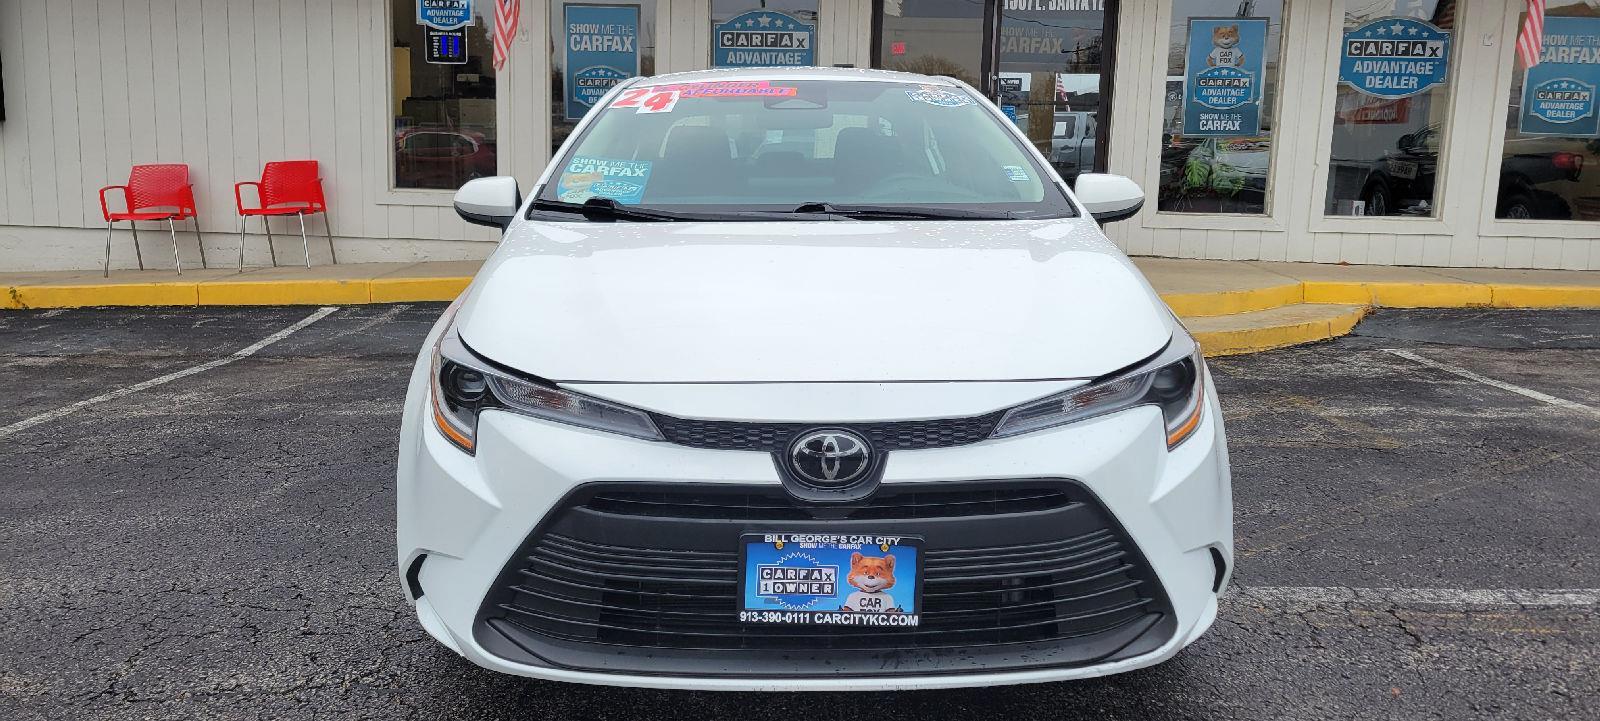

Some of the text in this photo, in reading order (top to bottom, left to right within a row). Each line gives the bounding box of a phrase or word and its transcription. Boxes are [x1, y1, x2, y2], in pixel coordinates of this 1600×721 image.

[424, 0, 467, 8] CARFAX
[570, 24, 634, 35] SHOW ME THE
[570, 35, 634, 52] CARFAX
[723, 33, 807, 48] CARFAX
[1542, 34, 1600, 46] HOW ME TH
[1350, 41, 1441, 57] CARFAX
[727, 51, 802, 64] ADVANTAGE
[1353, 61, 1434, 74] ADVANTAGE
[1200, 79, 1248, 87] CARFAX
[1366, 76, 1419, 89] DEALER
[581, 88, 608, 96] ADVAN
[684, 87, 789, 95] AFFORDABLE
[1201, 88, 1245, 96] ADVANTAGE
[1538, 92, 1589, 101] CARFAX
[1540, 102, 1584, 110] ADVANTAGE
[1546, 110, 1576, 118] DEALER
[1200, 121, 1241, 130] CARFAX
[573, 157, 608, 166] SHOW
[569, 163, 649, 176] CARFAX
[764, 534, 900, 546] BILL GEORGE'S CAR CITY
[761, 568, 835, 582] CARFAX
[774, 583, 835, 594] OWNER
[859, 597, 882, 608] CAR
[739, 611, 919, 627] 913-390-0111 CARCITYKC.COM
